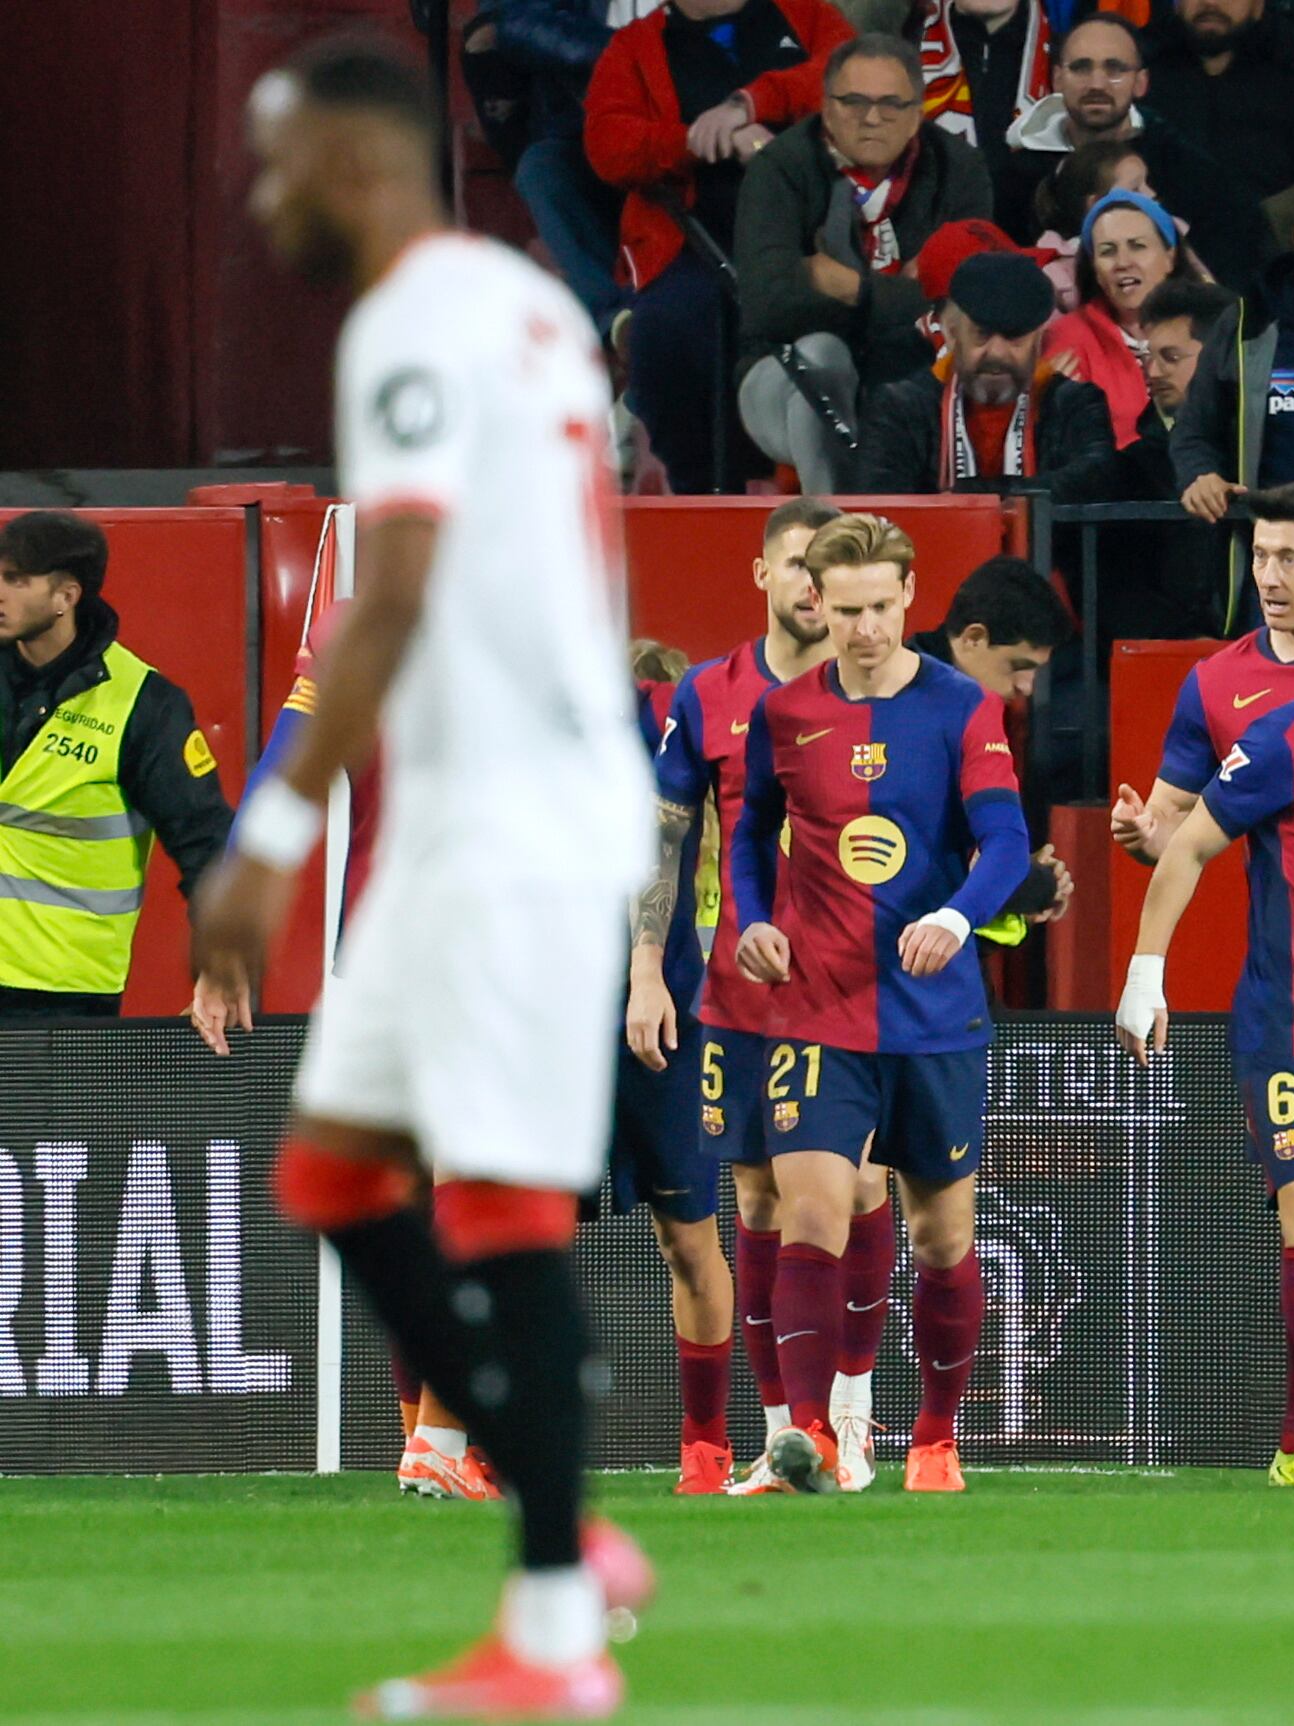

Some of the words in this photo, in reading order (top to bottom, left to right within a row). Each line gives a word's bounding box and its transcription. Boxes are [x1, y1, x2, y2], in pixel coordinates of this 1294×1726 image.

[55, 708, 115, 736] EGURIDAD
[43, 733, 98, 765] 2540
[702, 1041, 724, 1100] 5
[768, 1044, 820, 1100] 21
